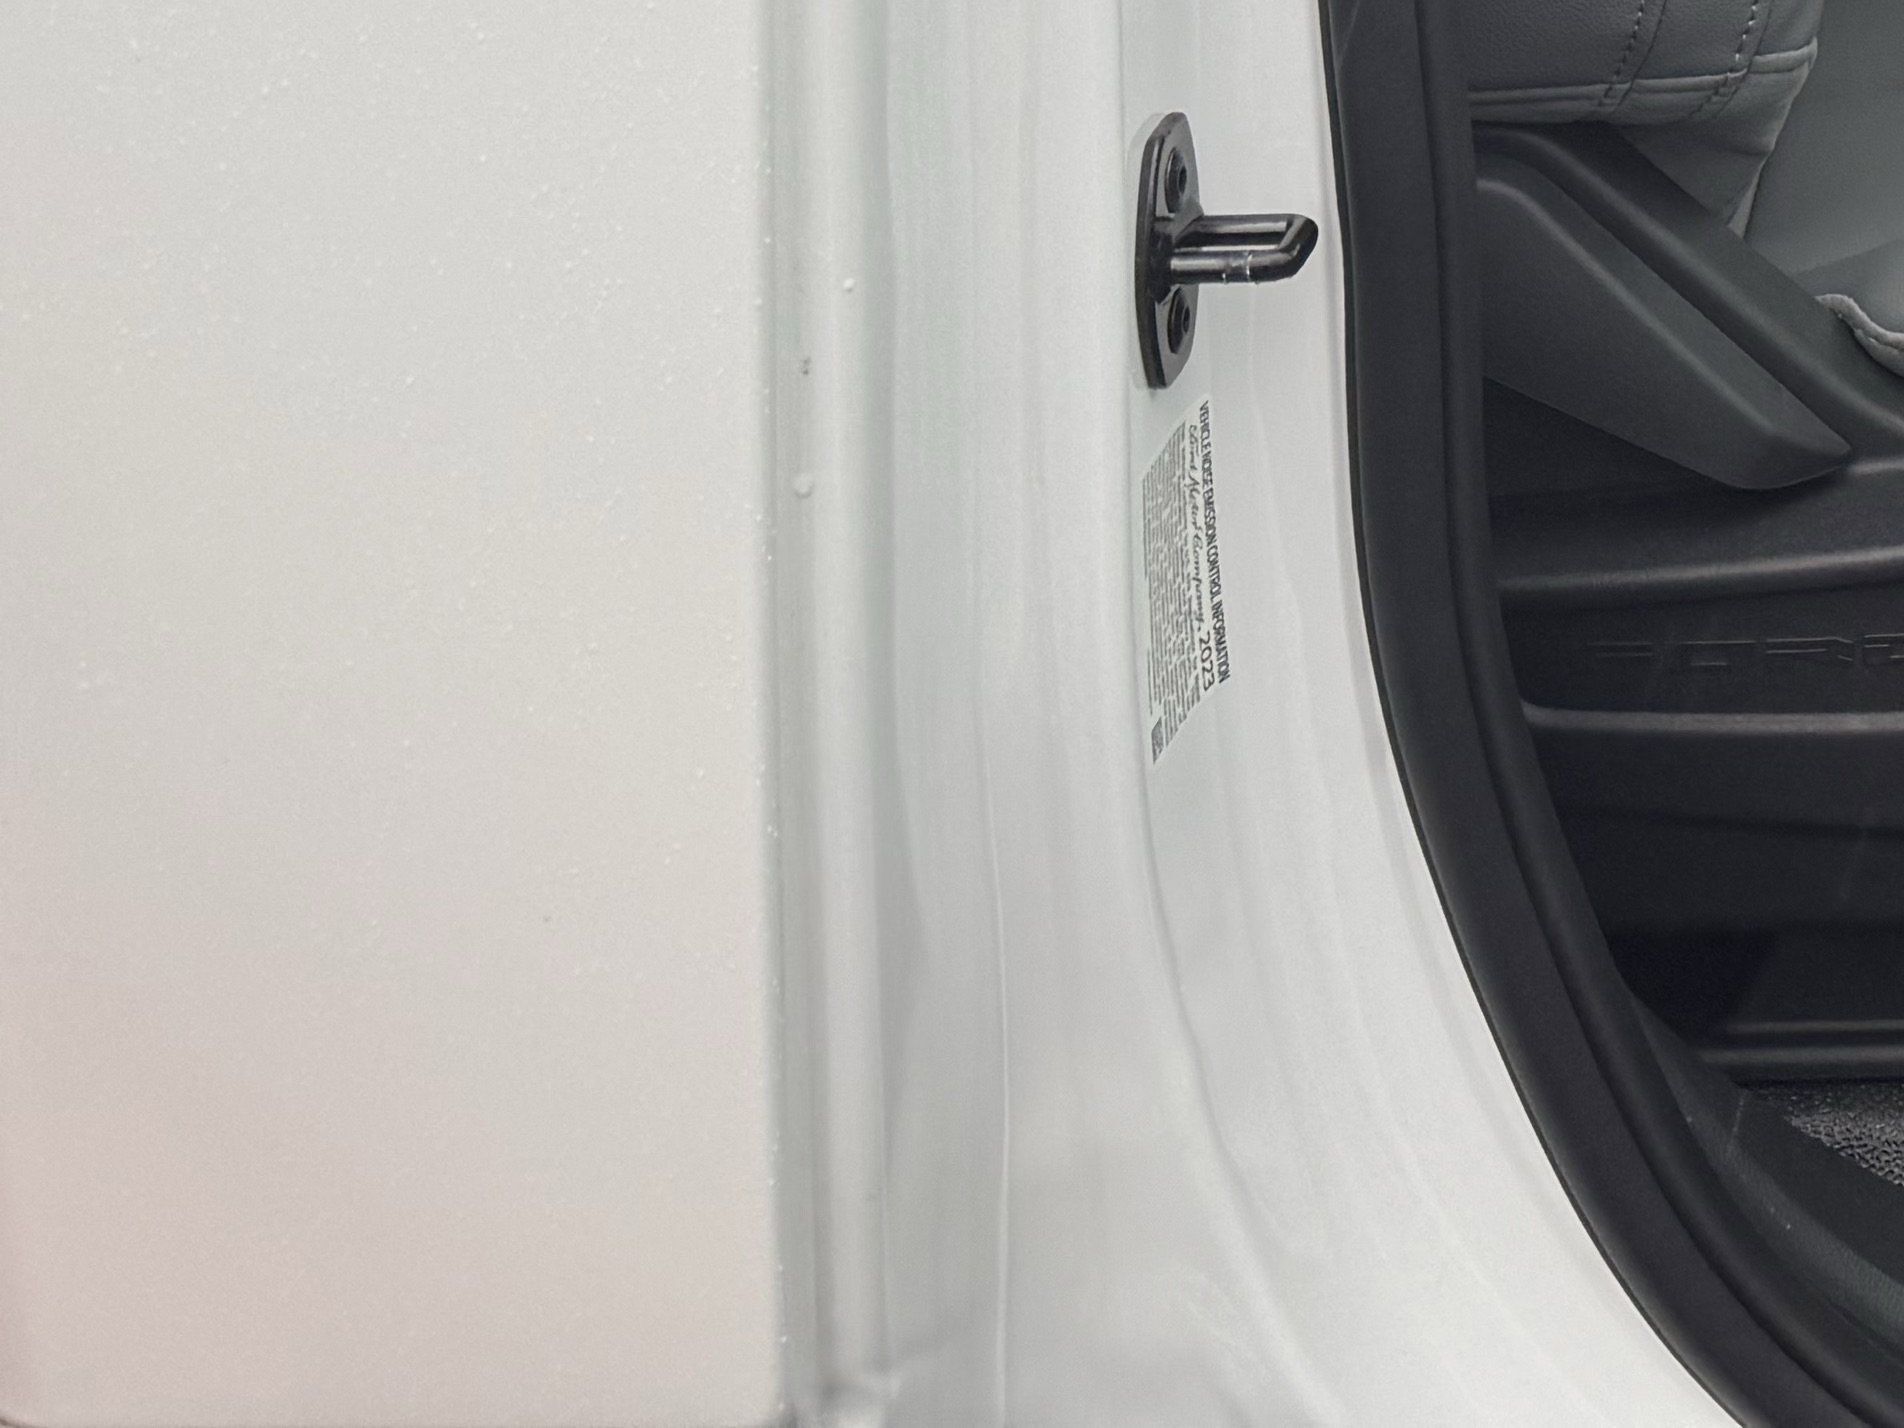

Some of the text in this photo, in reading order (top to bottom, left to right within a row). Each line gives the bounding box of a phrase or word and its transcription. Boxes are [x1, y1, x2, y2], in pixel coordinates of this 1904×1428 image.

[1199, 399, 1231, 685] VEHICLE NOISE EMISSION CONTROL INFORMATION
[1199, 630, 1215, 692] 2023
